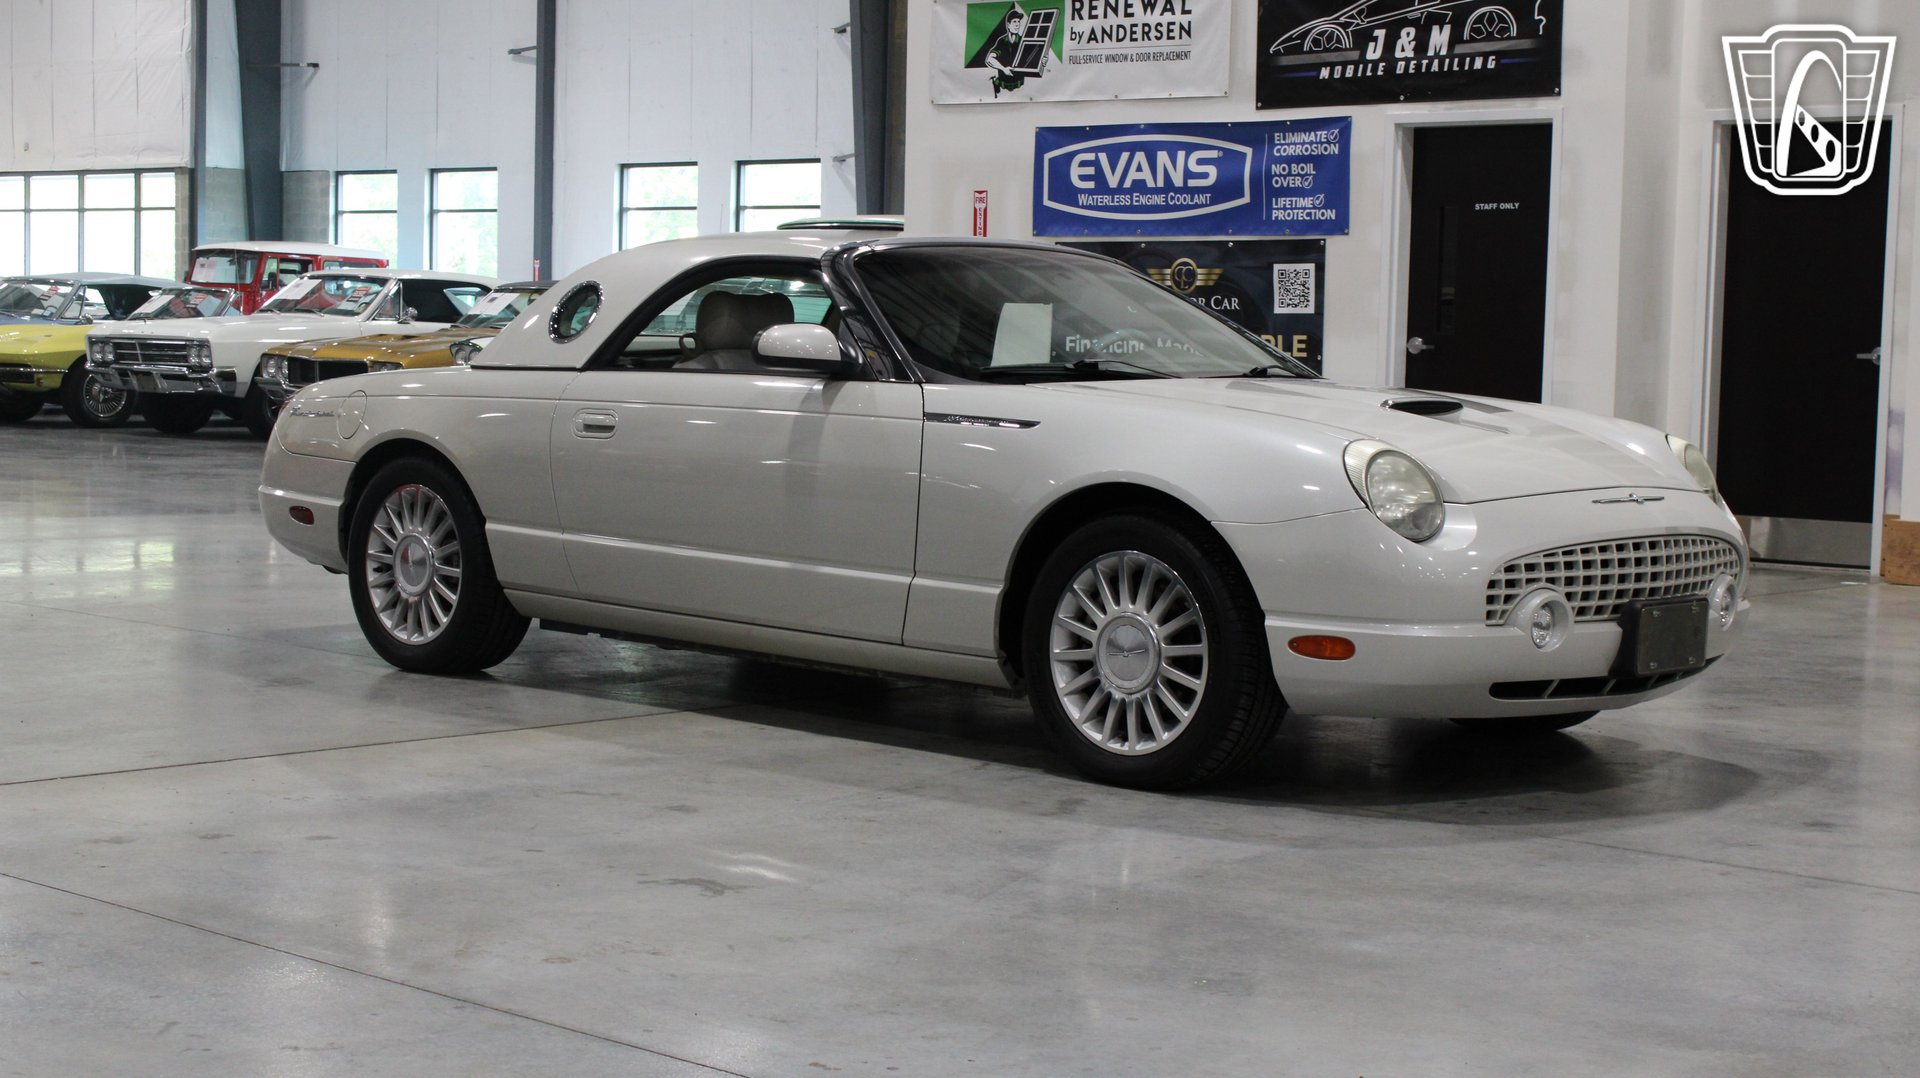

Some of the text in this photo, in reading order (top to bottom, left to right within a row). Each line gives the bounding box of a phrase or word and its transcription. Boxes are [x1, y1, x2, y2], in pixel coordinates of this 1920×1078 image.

[1071, 0, 1192, 20] RENEWAL
[1070, 21, 1192, 44] by ANDERSEN
[1069, 50, 1192, 65] FULL-SERVICE WINDOW & DOOR REPLACEMENT
[1319, 56, 1496, 79] MOBILE DETAILING
[1274, 131, 1328, 144] ELIMINATE
[1273, 143, 1339, 156] CORROSION
[1070, 150, 1219, 189] EVANS
[1271, 163, 1316, 175] NO BOIL
[1272, 176, 1302, 188] OVER
[975, 196, 986, 204] FIRE
[1078, 192, 1212, 206] WATERLESS ENGINE COOLANT
[1272, 197, 1313, 208] LIFETIME
[1499, 202, 1520, 210] ONLY
[1272, 209, 1336, 220] PROTECTION
[1210, 295, 1240, 310] CAR
